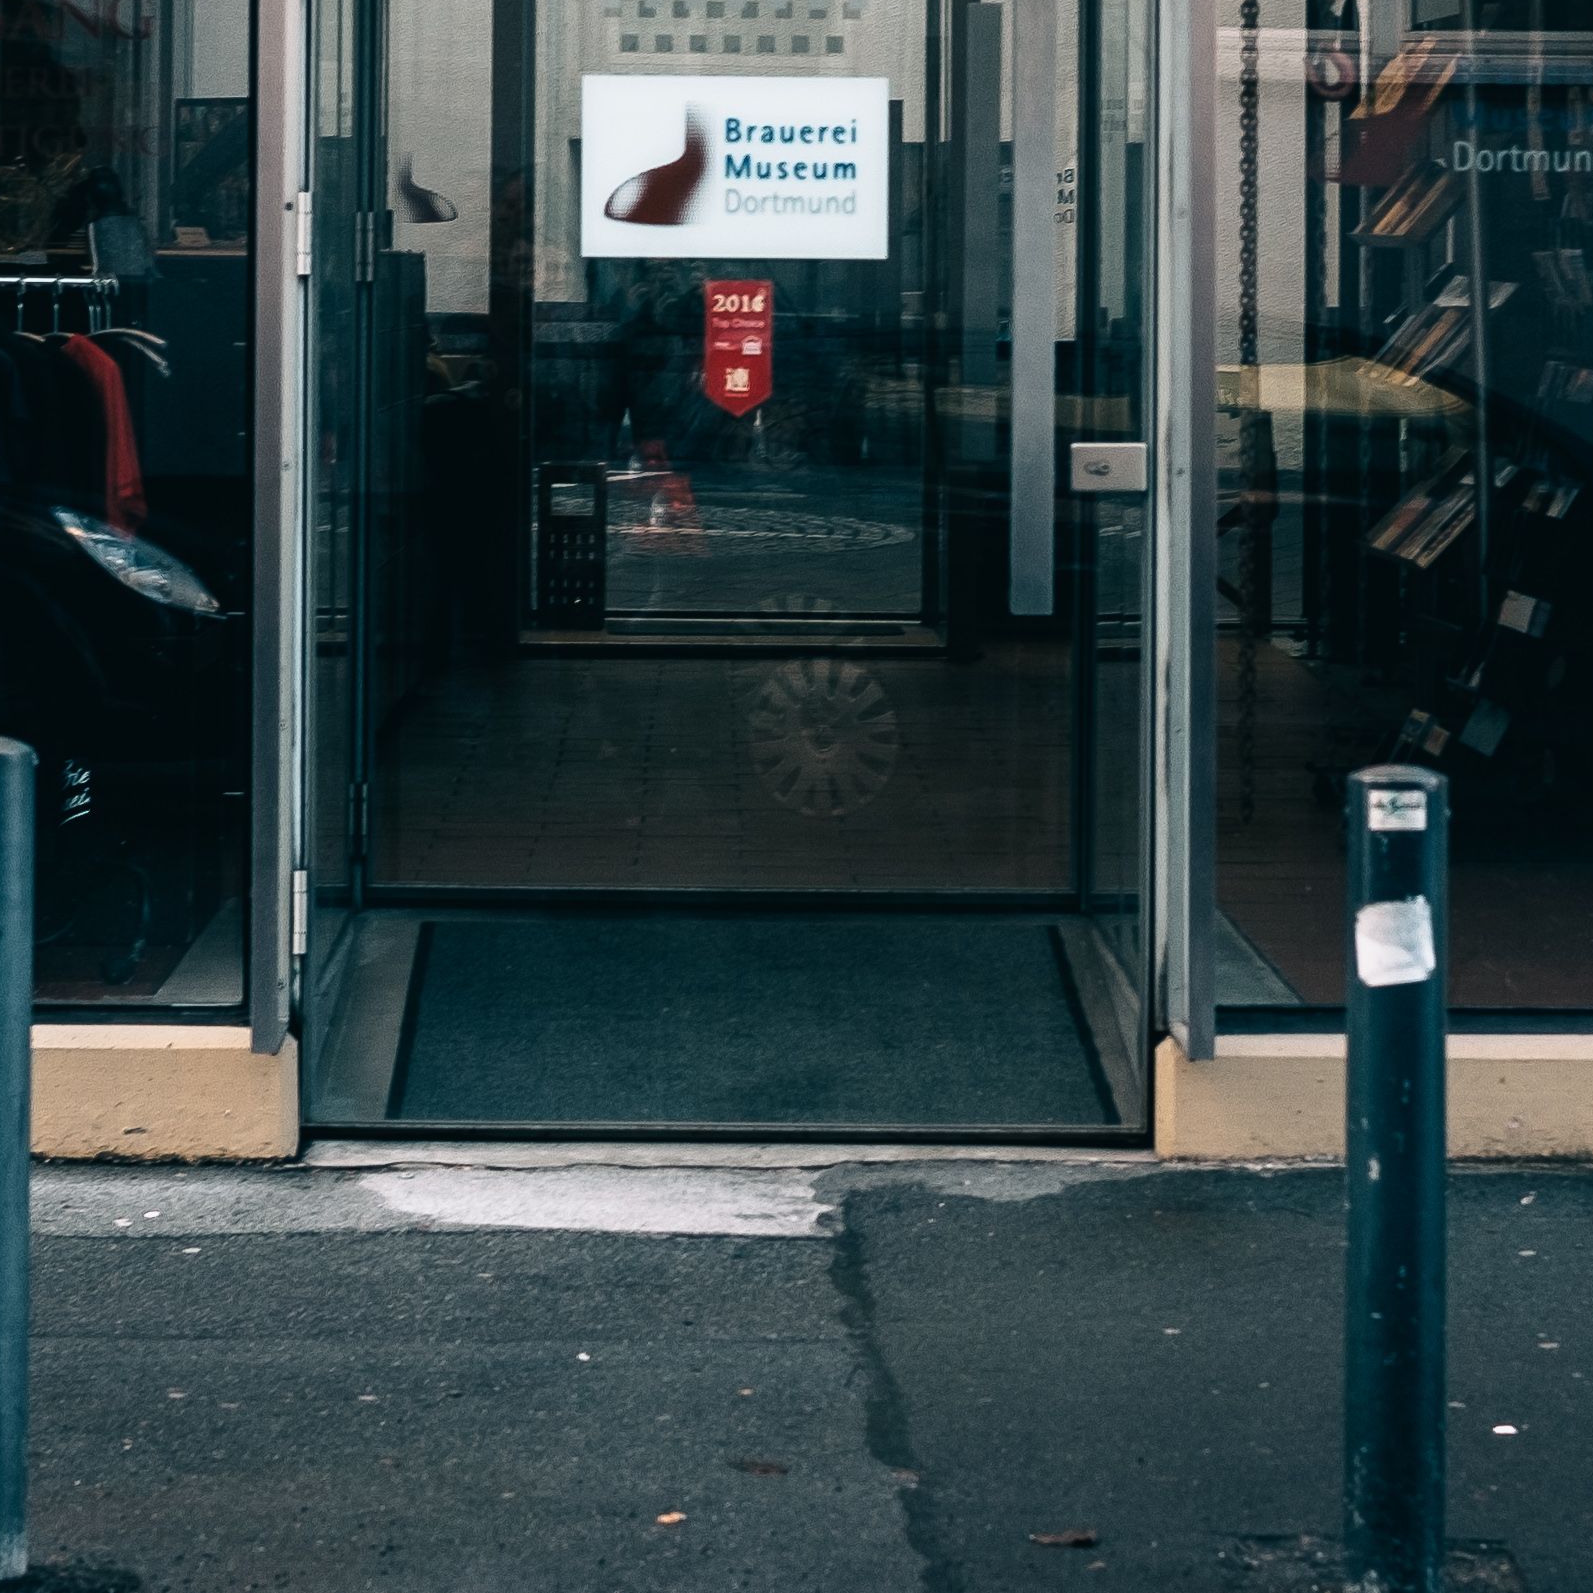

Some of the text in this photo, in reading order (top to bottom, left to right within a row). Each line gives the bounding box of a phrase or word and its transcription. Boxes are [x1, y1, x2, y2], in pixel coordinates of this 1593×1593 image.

[724, 117, 859, 145] Brauerei
[724, 154, 858, 181] Museum
[724, 188, 858, 216] Dortmund
